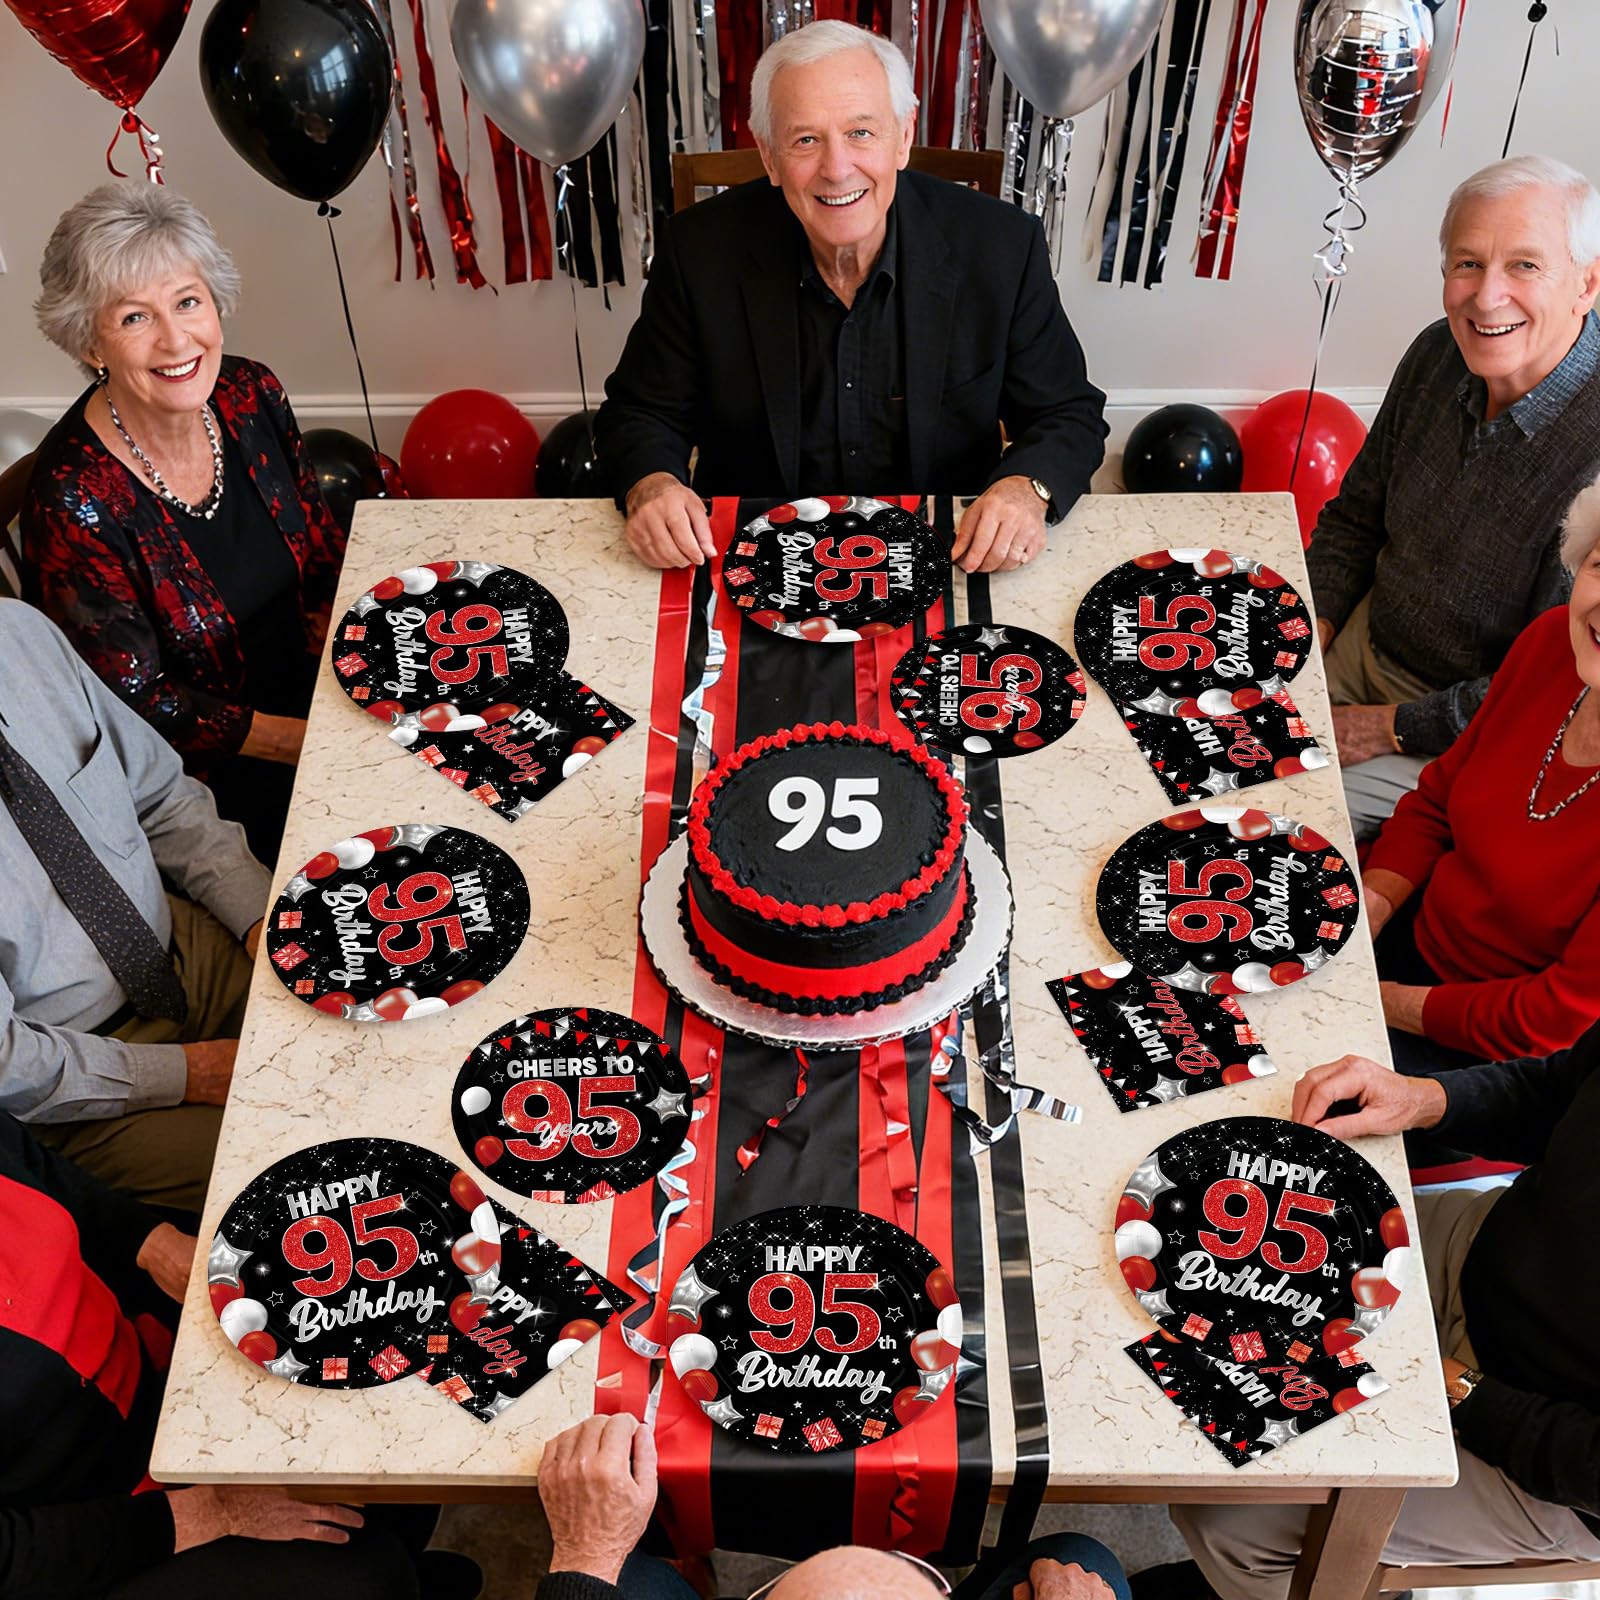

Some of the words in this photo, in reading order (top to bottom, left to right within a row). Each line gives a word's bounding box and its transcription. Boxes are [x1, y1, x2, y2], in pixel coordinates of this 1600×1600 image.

[769, 531, 815, 609] Birthday
[888, 542, 913, 592] HAPPY
[384, 607, 429, 698] Birthday
[503, 608, 534, 664] HAPPY
[1112, 604, 1138, 662] HAPPY
[1213, 589, 1264, 678] Birthday
[940, 654, 959, 672] TO
[939, 673, 959, 726] CHEERS
[960, 654, 1042, 732] 95
[508, 708, 558, 741] PPY
[1182, 717, 1225, 756] HAP
[768, 776, 883, 851] 95
[452, 870, 493, 933] HAPPY
[1139, 870, 1167, 932] HAPPY
[1251, 852, 1307, 951] Birthday
[322, 883, 377, 988] Birthday
[1124, 1005, 1173, 1063] HAPPY
[506, 1057, 598, 1078] CHEERS
[603, 1055, 634, 1074] TO
[502, 1075, 641, 1161] 95
[286, 1170, 381, 1220] HAPPY
[1226, 1150, 1328, 1193] HAPPY
[765, 1246, 863, 1271] HAPPY
[289, 1280, 445, 1343] Birthday
[489, 1285, 543, 1324] PPY
[1175, 1250, 1325, 1327] Birthday
[736, 1351, 892, 1404] Birthday
[1215, 1359, 1276, 1408] HAPP
